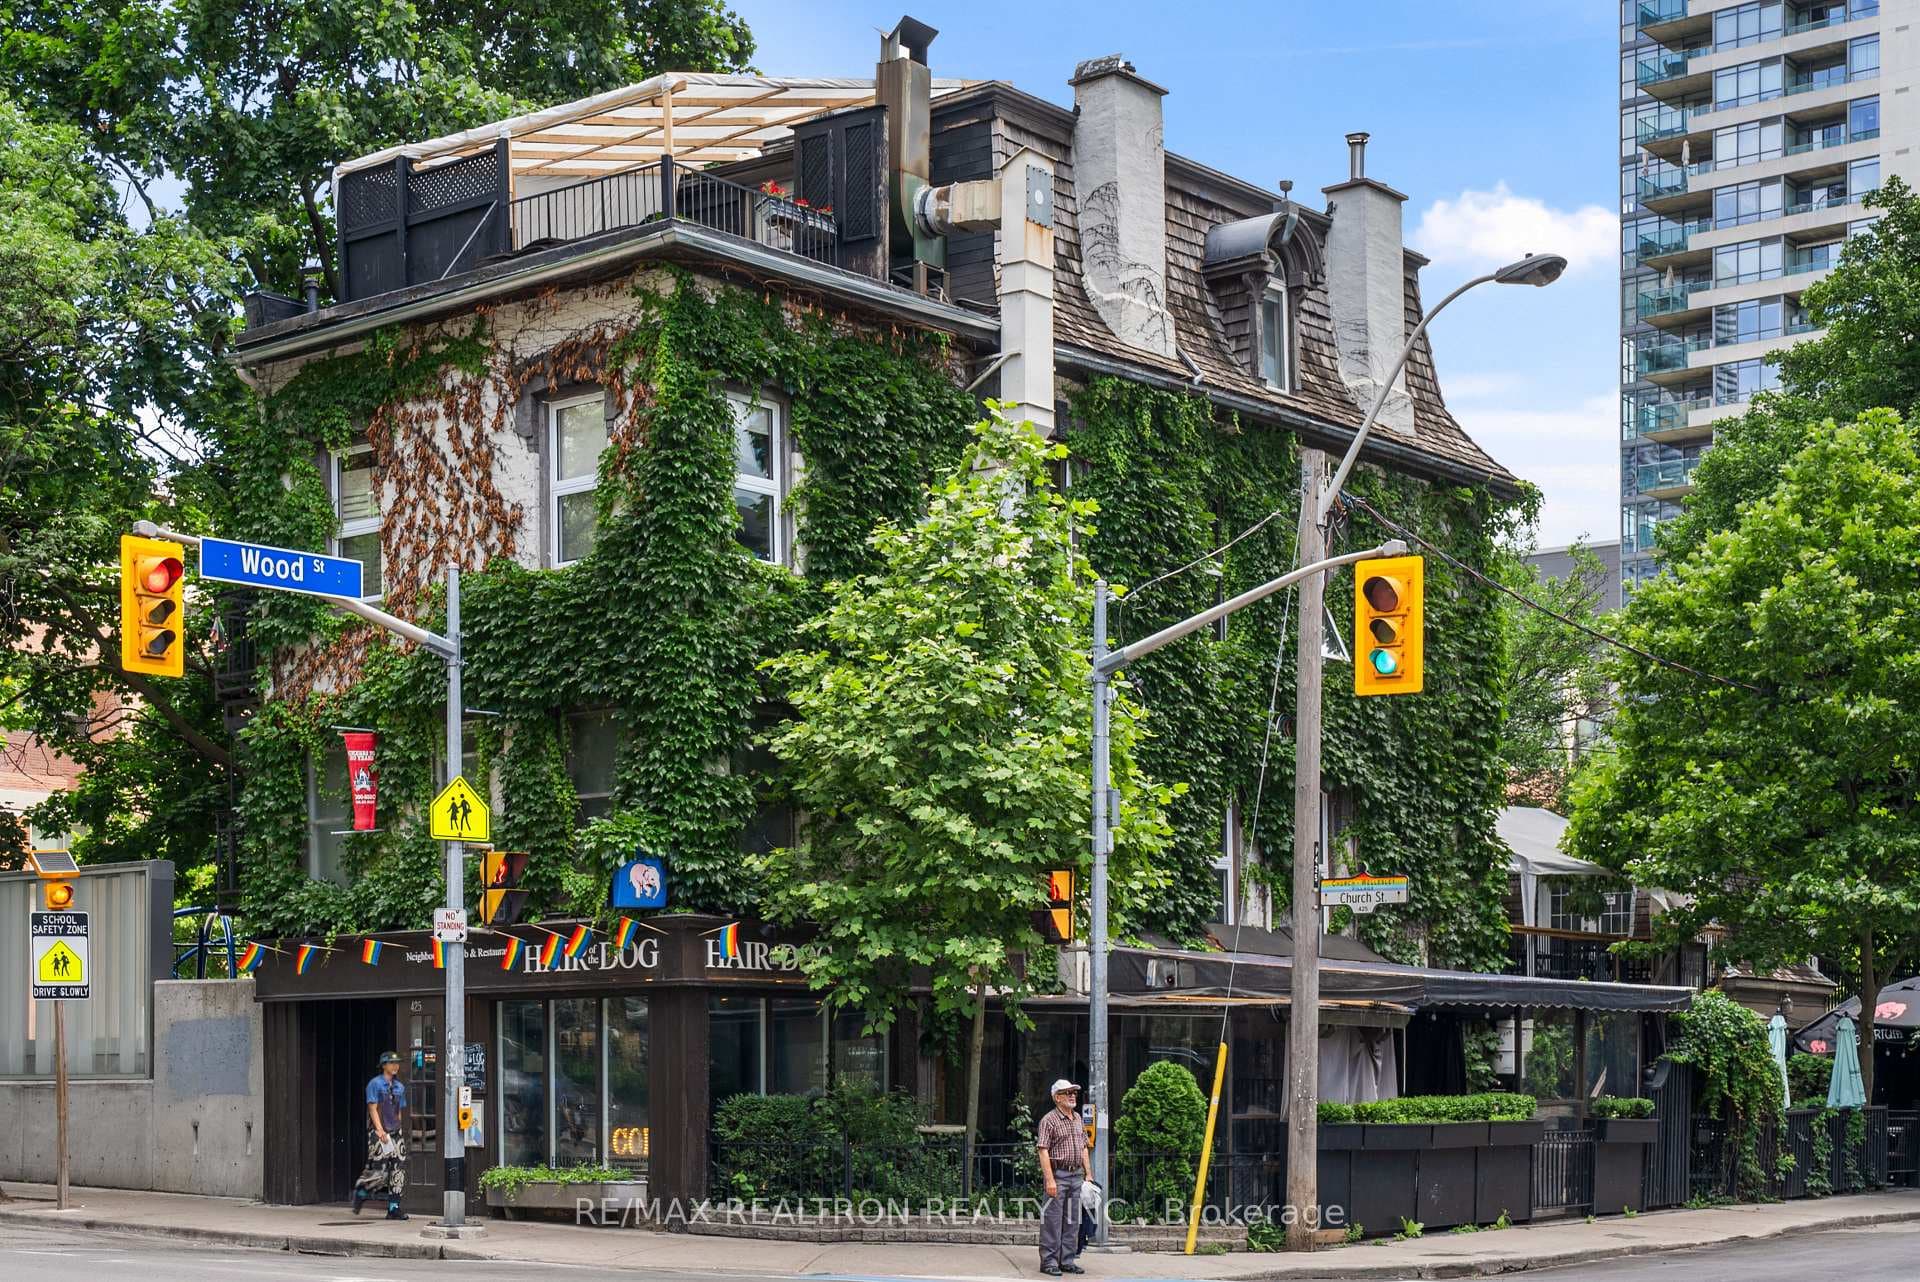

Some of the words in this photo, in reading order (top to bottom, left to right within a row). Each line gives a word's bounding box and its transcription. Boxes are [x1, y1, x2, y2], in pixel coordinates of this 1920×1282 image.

[240, 547, 304, 582] Wood
[313, 559, 326, 574] St
[1340, 891, 1372, 904] Church
[42, 915, 78, 924] SCHOOL
[445, 912, 456, 920] NO
[32, 925, 64, 934] SAFETY
[66, 925, 88, 934] ZONE
[436, 922, 465, 931] STANDING
[588, 944, 598, 954] of
[406, 951, 435, 963] Neighbo
[469, 948, 477, 958] &
[587, 954, 600, 965] the
[33, 987, 57, 997] DRIVE
[60, 987, 89, 997] SLOWLY
